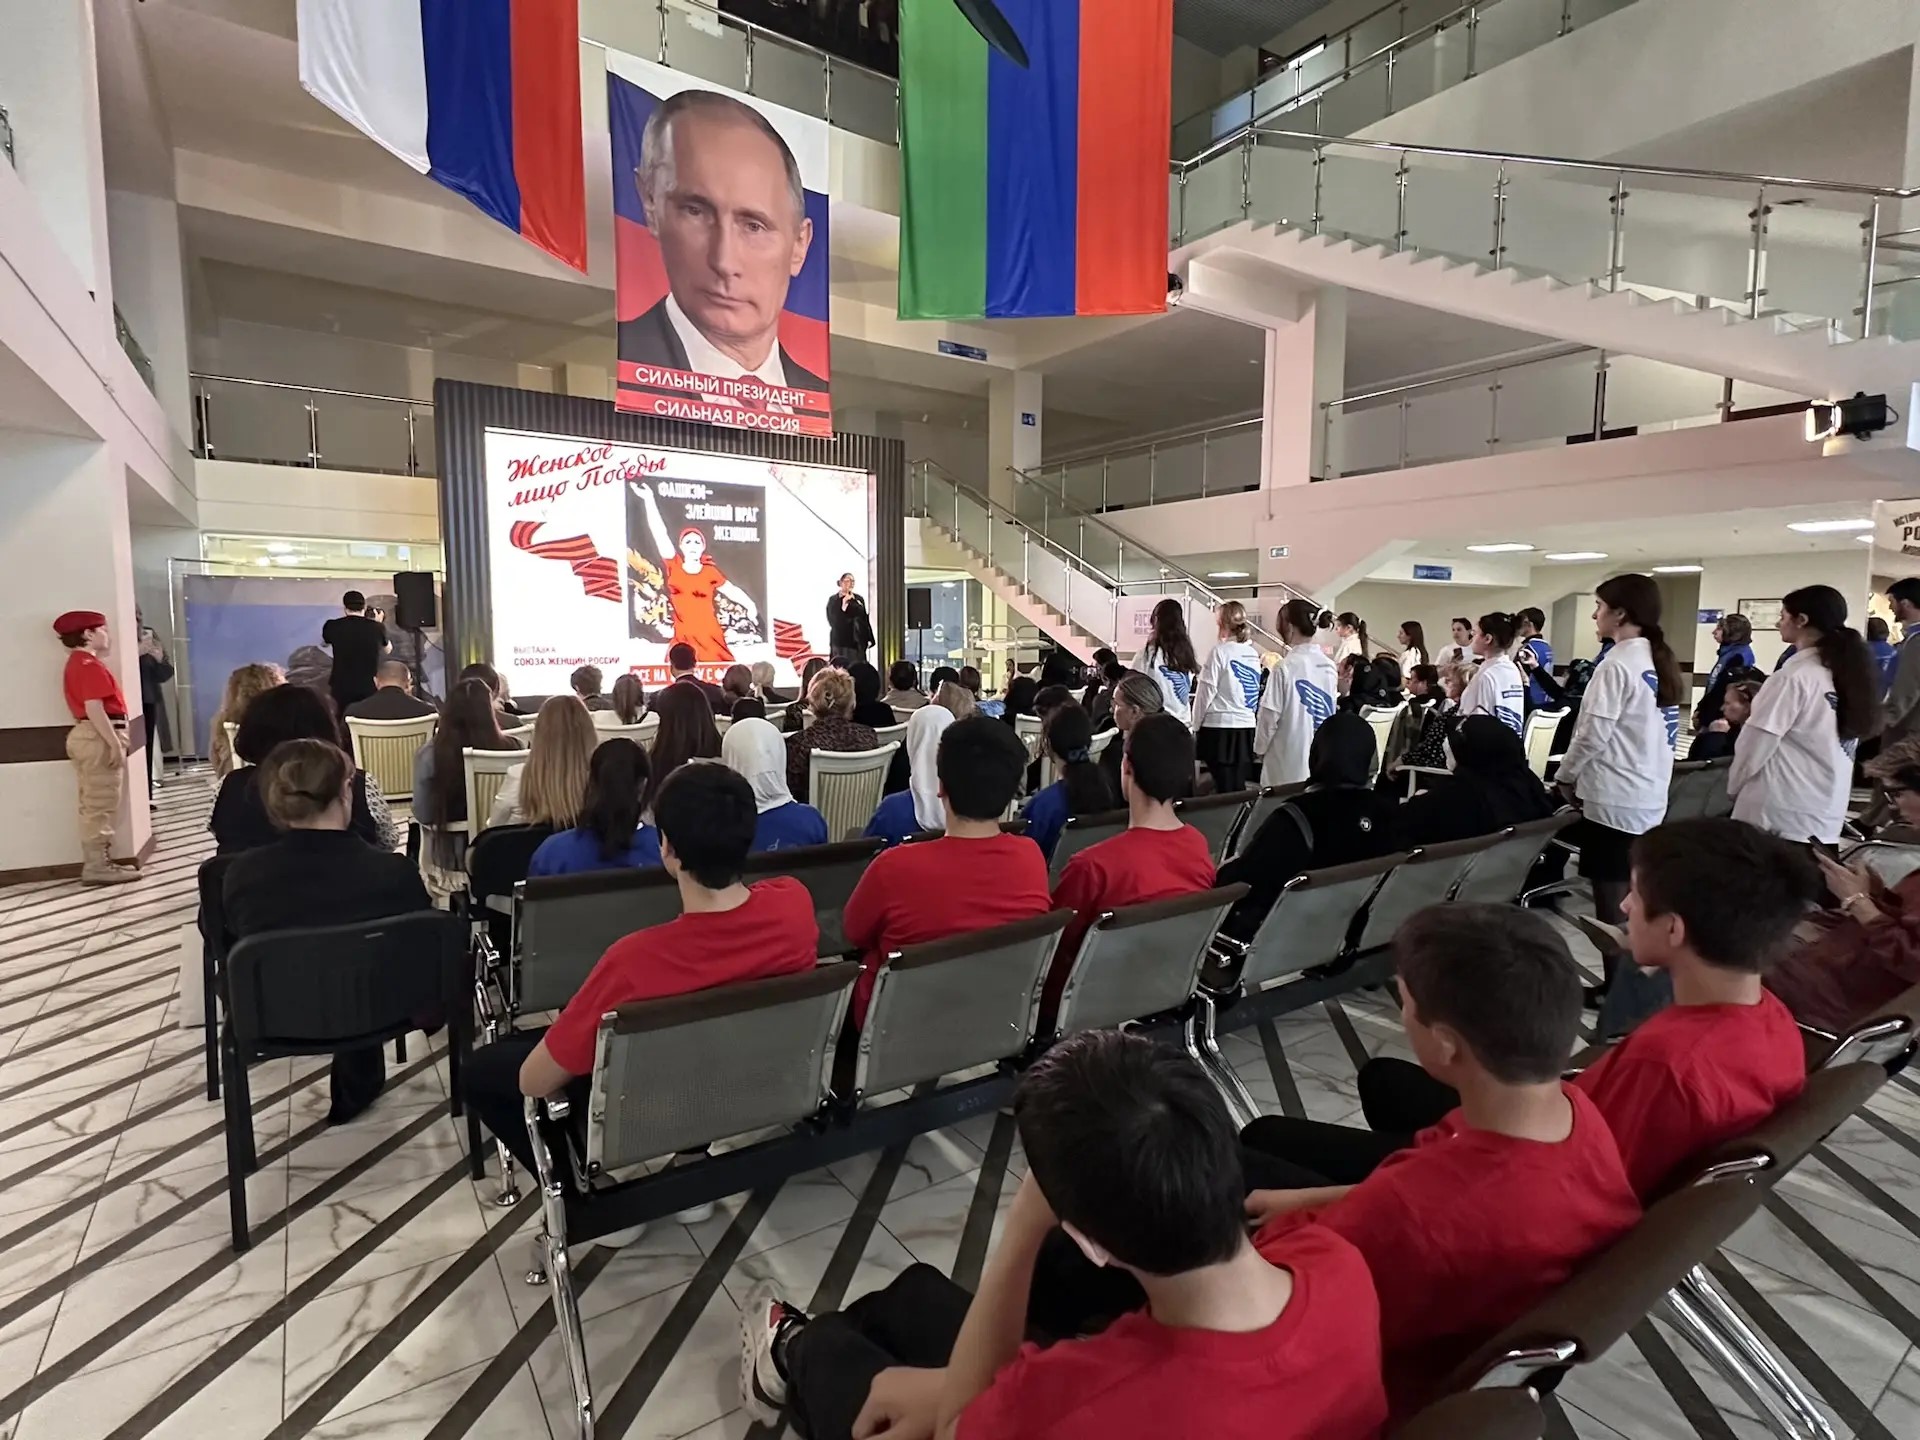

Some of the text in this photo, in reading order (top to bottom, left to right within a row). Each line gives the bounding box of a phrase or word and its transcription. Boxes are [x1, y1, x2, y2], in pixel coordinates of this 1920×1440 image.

[635, 367, 720, 394] СИЛЬНЫЙ
[724, 382, 805, 406] ПРЕЗИДЕНТ
[654, 399, 800, 432] СИЛЬНАЯ РОССИЯ
[507, 442, 614, 482] Женское
[508, 453, 668, 507] лицо Победы
[735, 506, 759, 522] ВРАГ
[514, 656, 620, 666] СОЮЗА ЖЕНЩИН РОССИИ
[654, 668, 667, 682] НА
